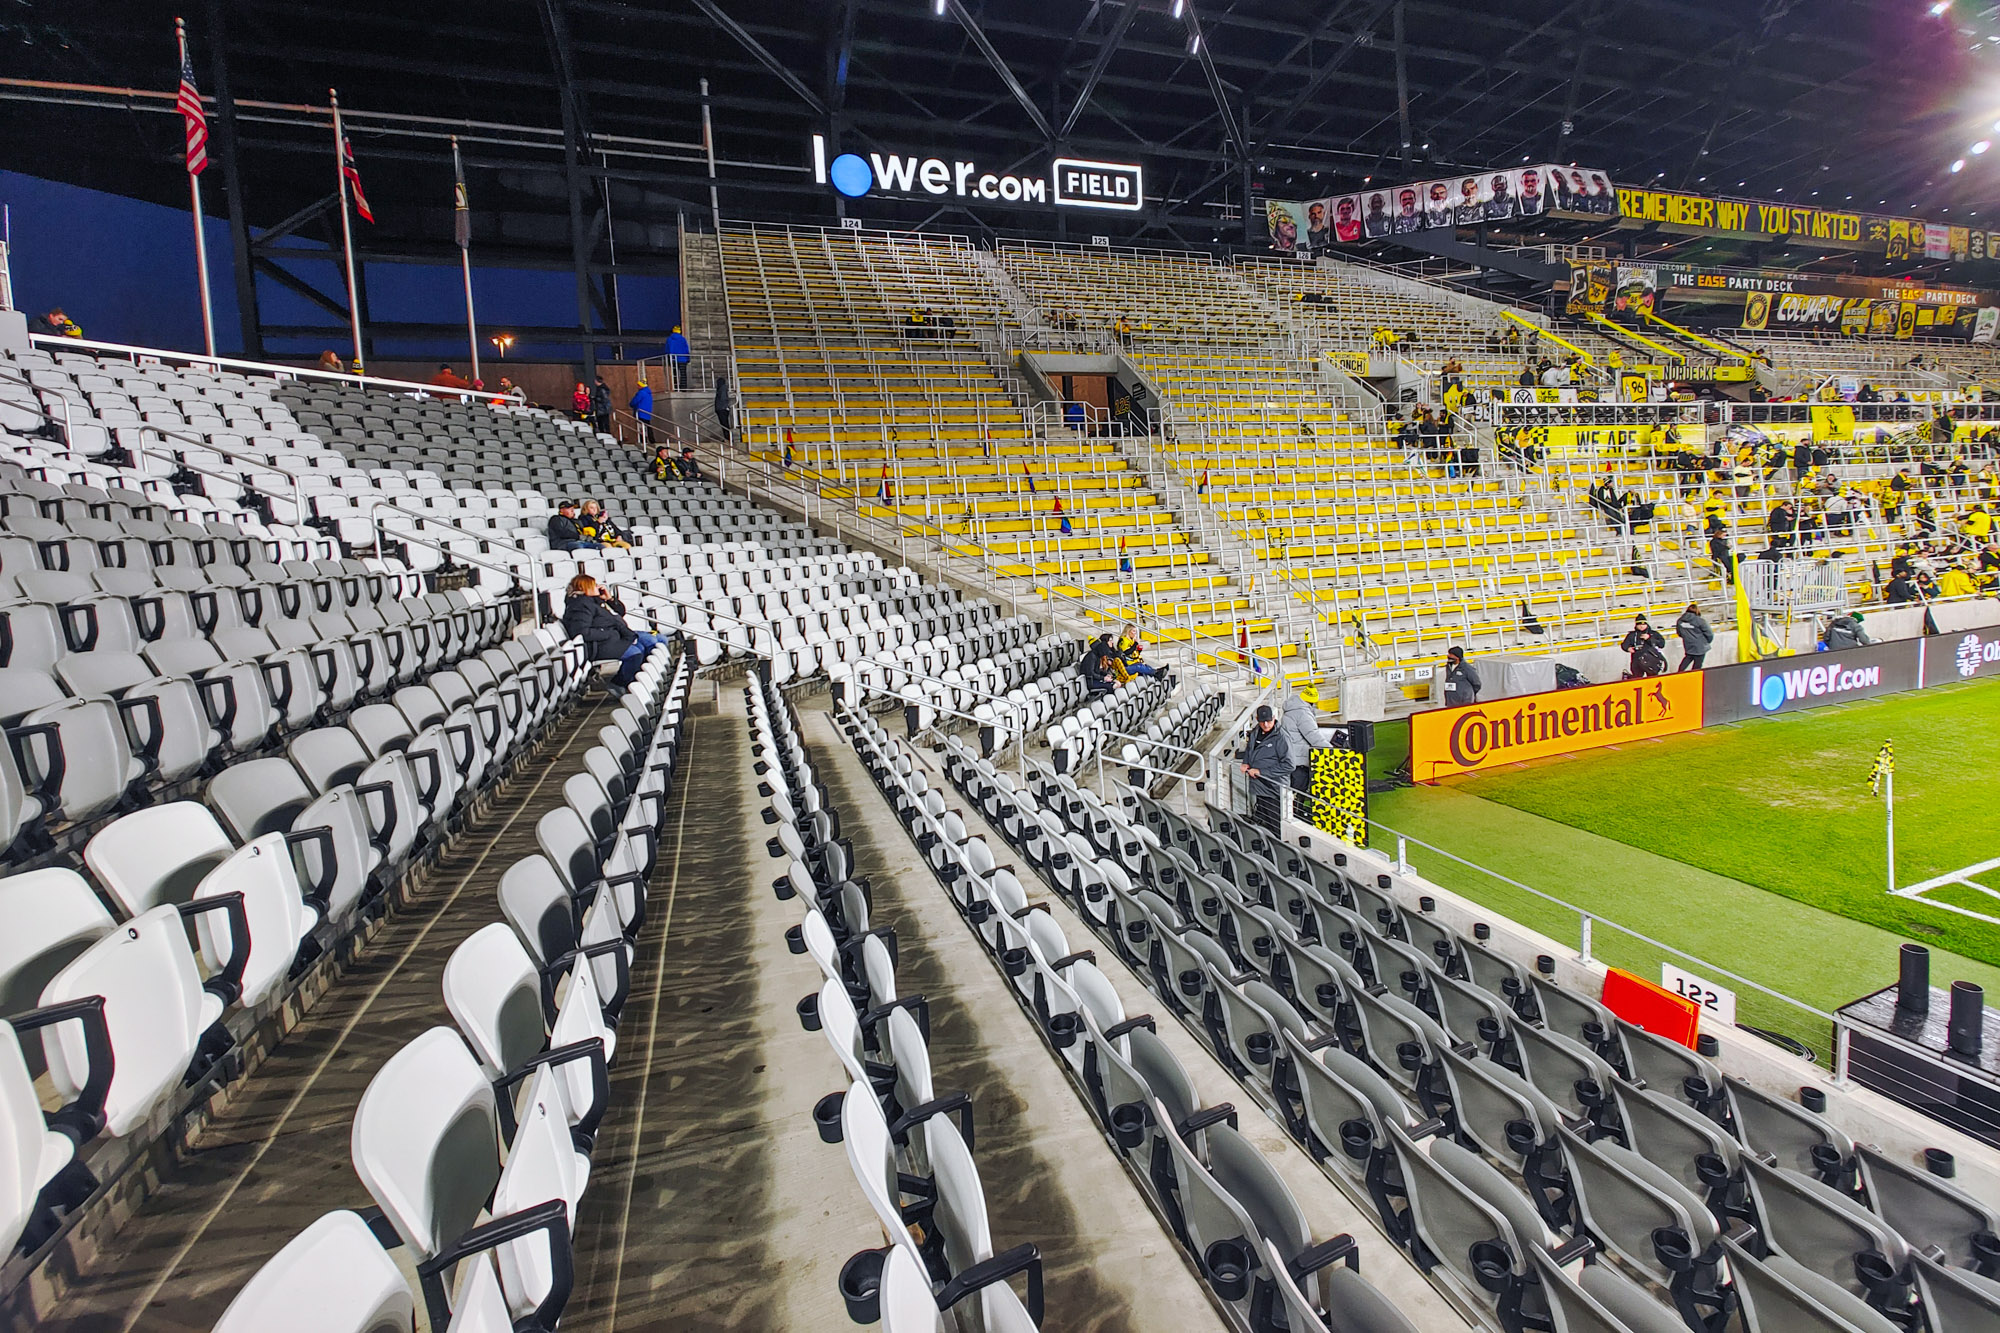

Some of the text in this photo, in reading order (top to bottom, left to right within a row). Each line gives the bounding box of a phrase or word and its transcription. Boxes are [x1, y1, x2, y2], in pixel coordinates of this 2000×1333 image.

[1067, 172, 1130, 198] FIELD
[844, 219, 859, 229] 124
[1618, 189, 1861, 241] REMEMBER WHY YOU STARTED
[1093, 237, 1107, 246] 125
[1672, 273, 1695, 287] THE
[1697, 274, 1726, 288] EASE
[1729, 277, 1763, 292] PARTY
[1766, 280, 1793, 292] DECK
[1882, 288, 1899, 299] THE
[1926, 291, 1953, 304] PARTY
[1955, 294, 1977, 305] DECK
[1663, 366, 1717, 381] NORDECKE
[1631, 381, 1643, 394] 96
[1114, 396, 1131, 415] 125
[1576, 431, 1600, 453] WE
[1390, 669, 1430, 680] 124 125
[1448, 687, 1644, 767] Continental
[1676, 978, 1719, 1011] 122
